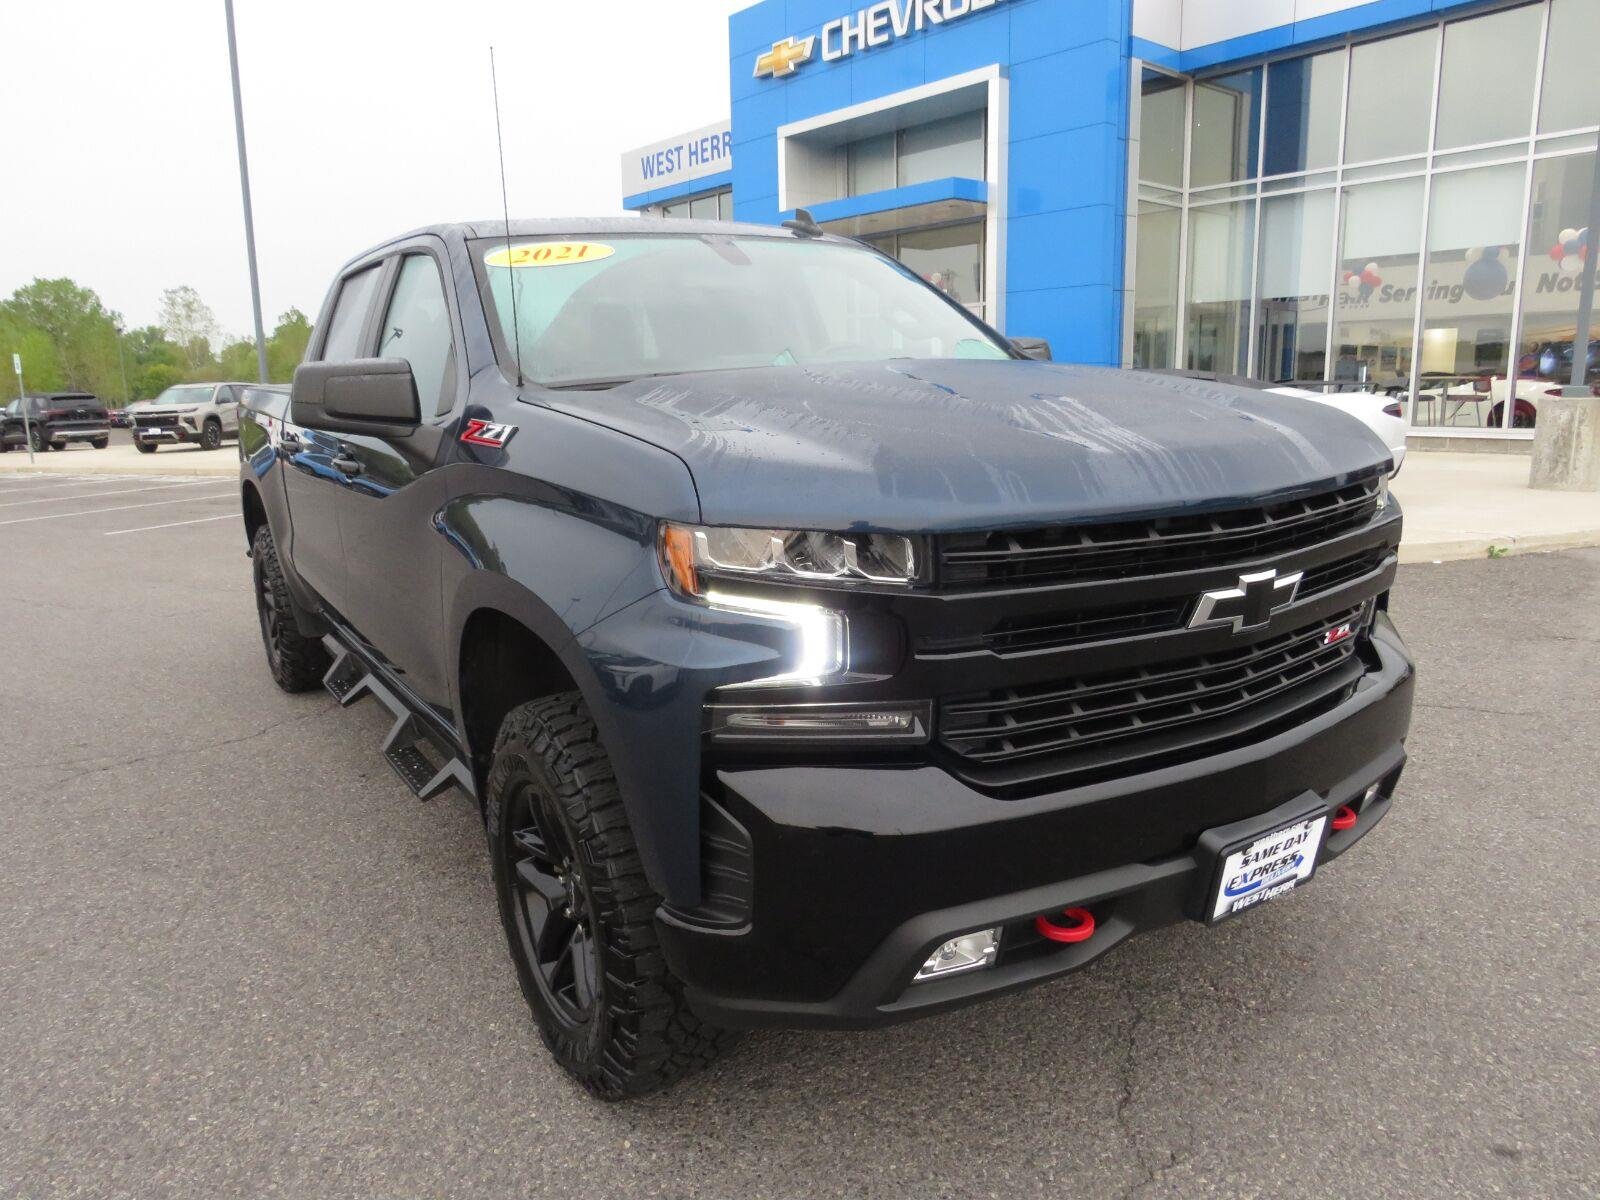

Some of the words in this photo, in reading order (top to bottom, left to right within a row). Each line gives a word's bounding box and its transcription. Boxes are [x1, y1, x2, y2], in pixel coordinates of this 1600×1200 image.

[641, 146, 683, 180] WEST
[688, 131, 732, 167] HERR
[514, 245, 588, 264] 2021
[1379, 279, 1464, 304] Sering
[460, 418, 519, 449] Z71
[1240, 842, 1284, 869] SAME
[1283, 829, 1313, 851] DAY
[1229, 850, 1301, 890] EXPRESS
